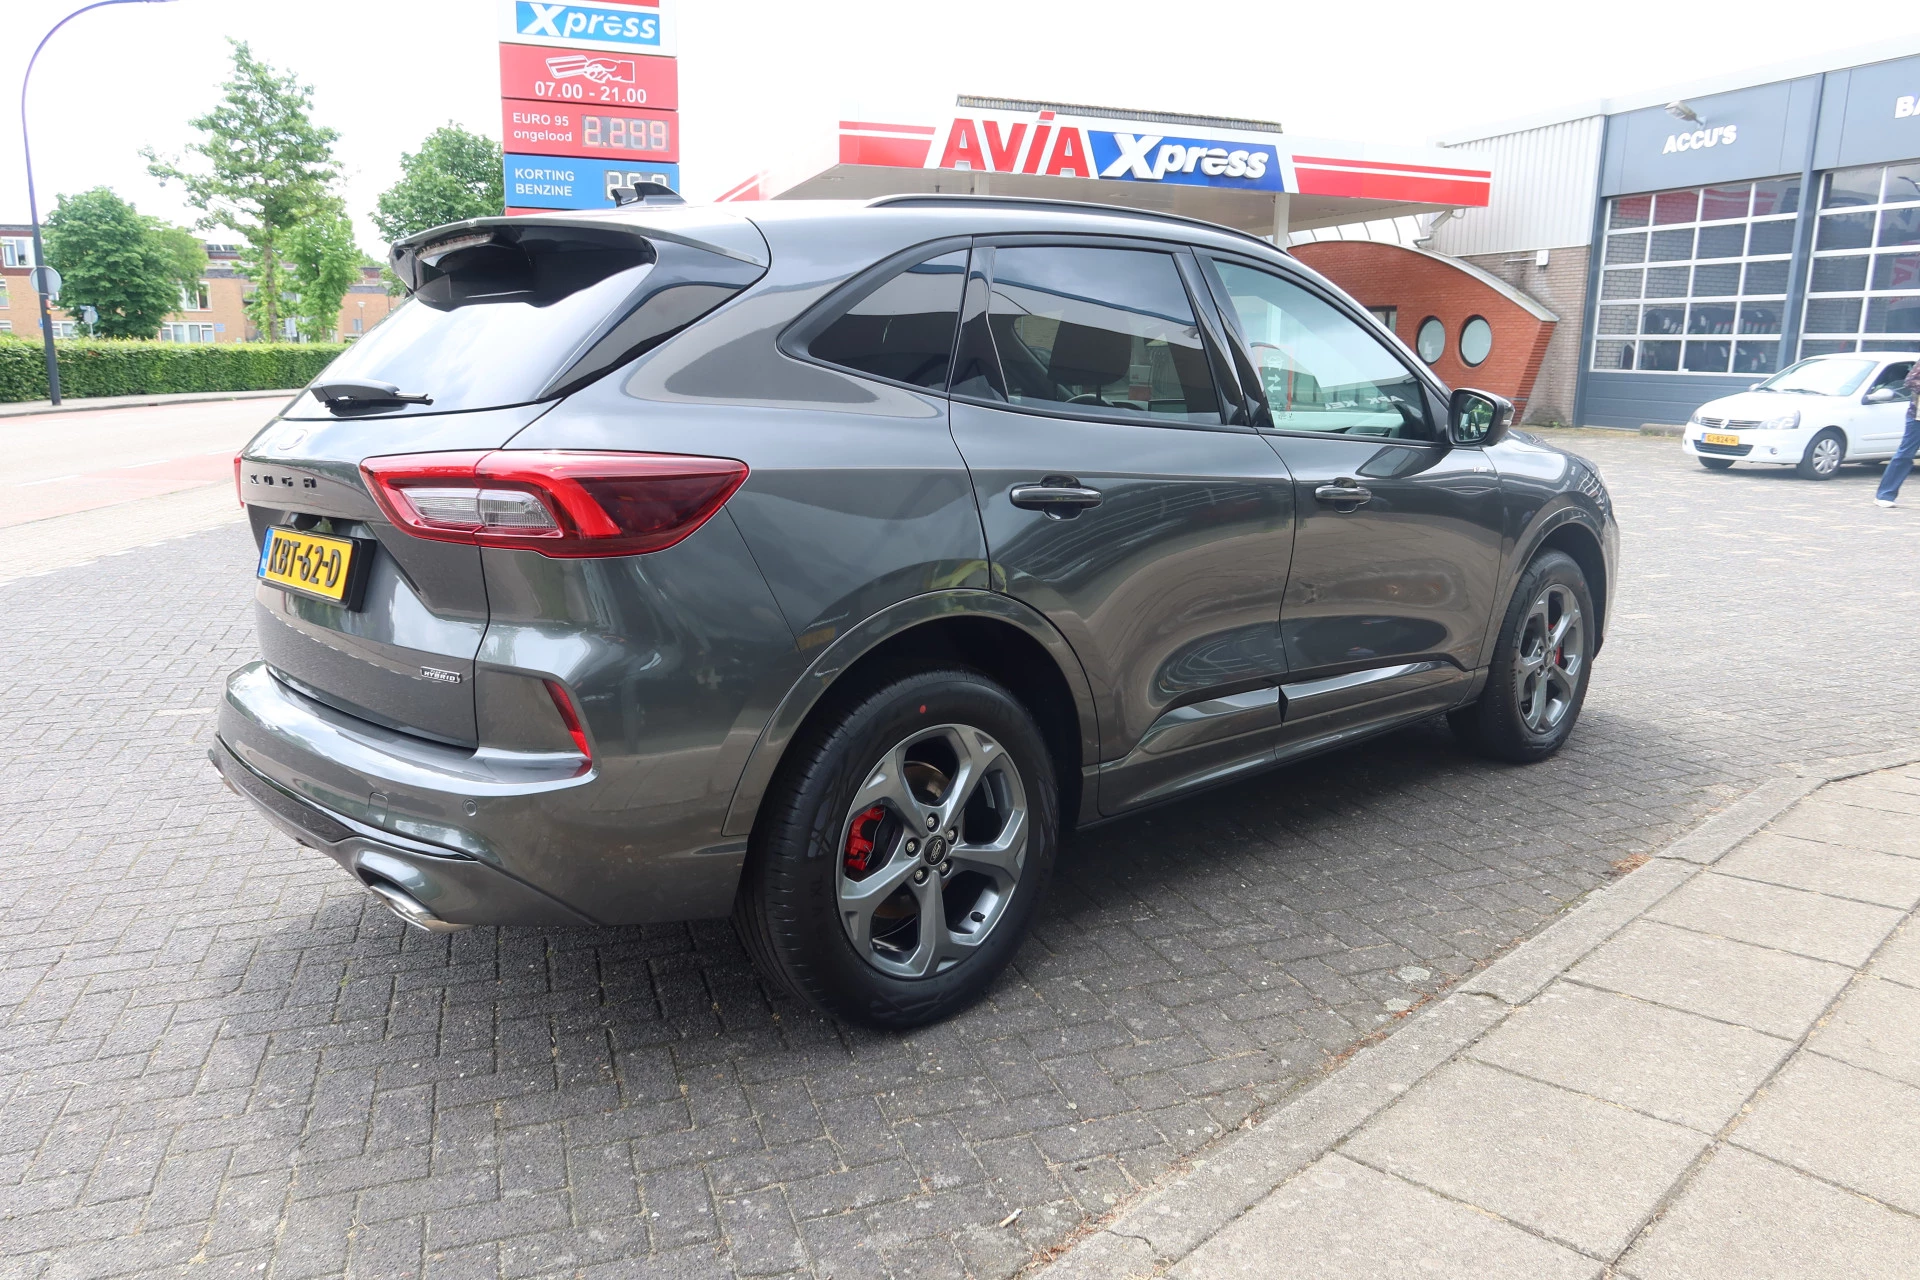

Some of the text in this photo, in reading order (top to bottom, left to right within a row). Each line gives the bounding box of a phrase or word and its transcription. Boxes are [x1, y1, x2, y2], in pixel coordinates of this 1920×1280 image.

[521, 3, 656, 38] Xpress
[534, 81, 583, 99] 07.00
[600, 86, 647, 103] 21.00
[512, 112, 569, 126] EURO 95
[513, 130, 573, 142] ongelood
[584, 116, 667, 150] 2.249
[1662, 124, 1737, 154] ACCU'S
[939, 111, 1269, 180] AVIA Xpress
[514, 168, 575, 182] KORTING
[515, 184, 573, 196] BENZINE
[268, 537, 342, 588] KBT-62-D
[424, 671, 456, 681] HYBRID
